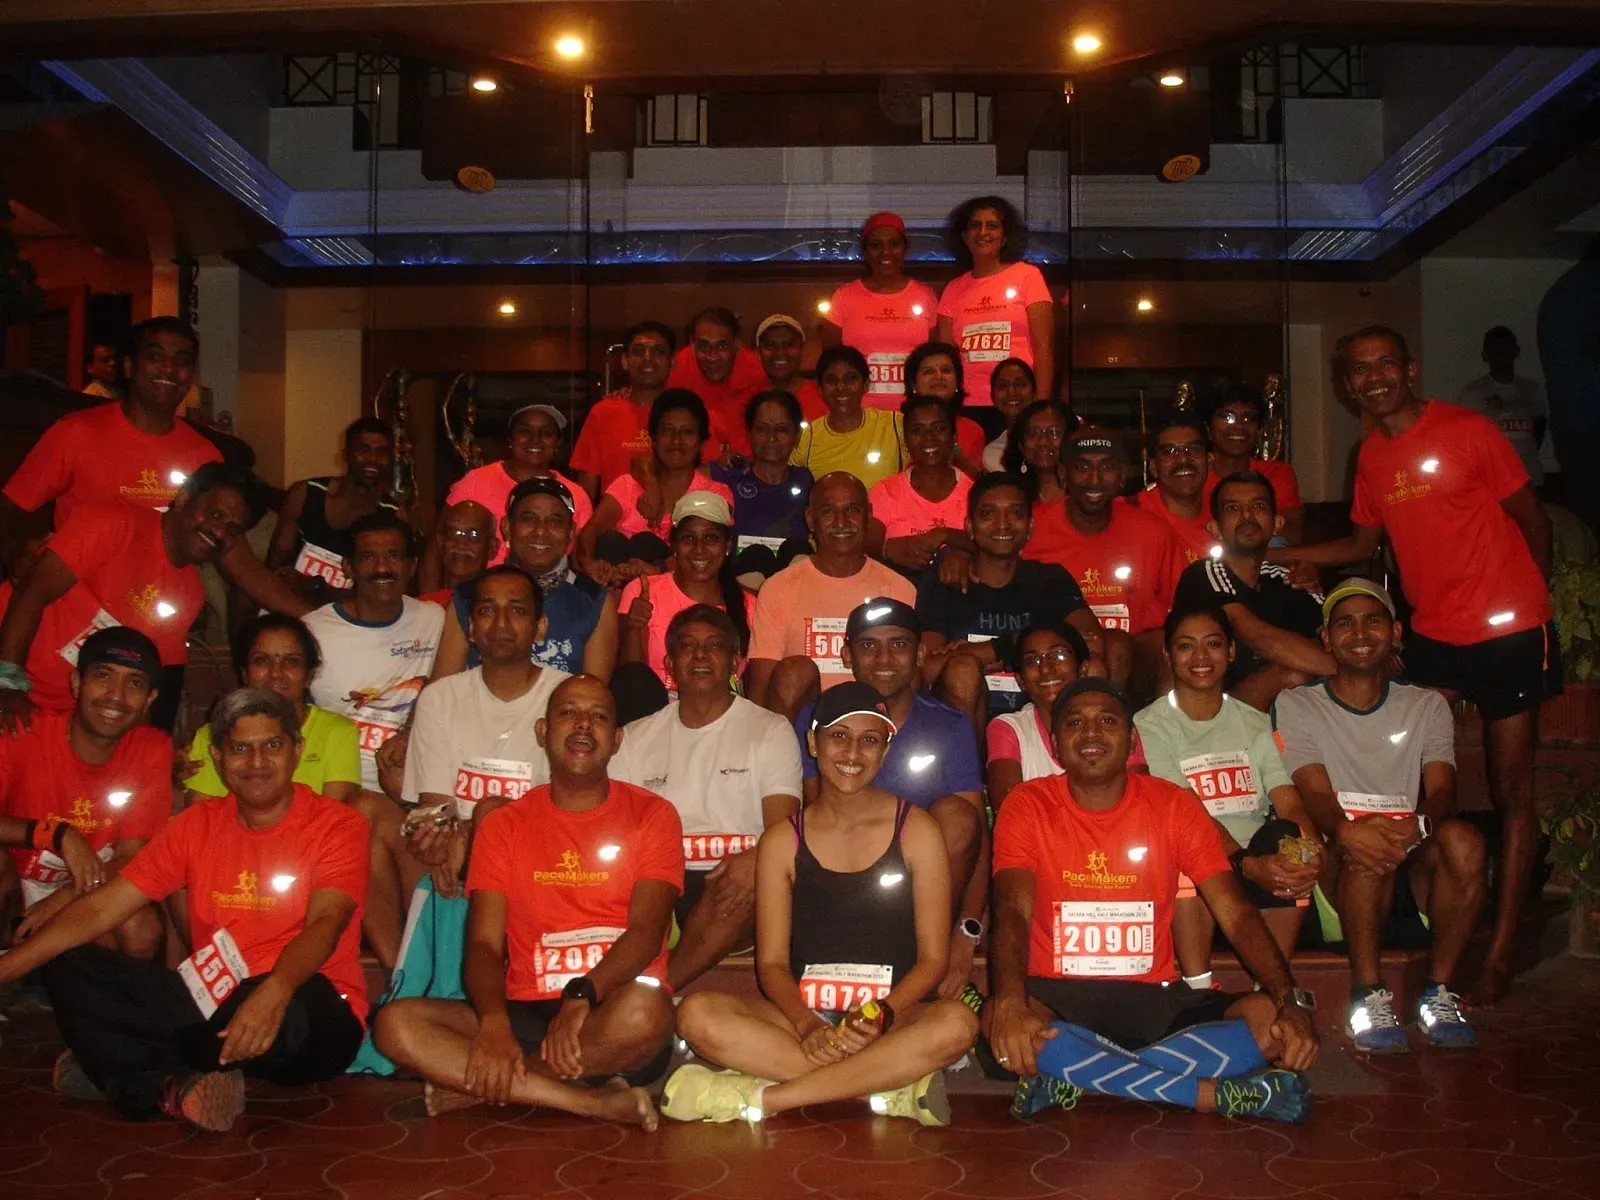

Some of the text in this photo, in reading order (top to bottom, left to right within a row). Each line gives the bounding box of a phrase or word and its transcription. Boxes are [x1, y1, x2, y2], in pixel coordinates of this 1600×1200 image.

[962, 334, 1002, 350] 4762
[359, 726, 398, 749] 13
[456, 773, 519, 801] 2093
[531, 871, 610, 882] PaceMakers
[1062, 870, 1137, 883] PaceMakers
[1064, 925, 1142, 953] 2090
[545, 944, 612, 971] 208
[804, 982, 873, 1011] 1972
